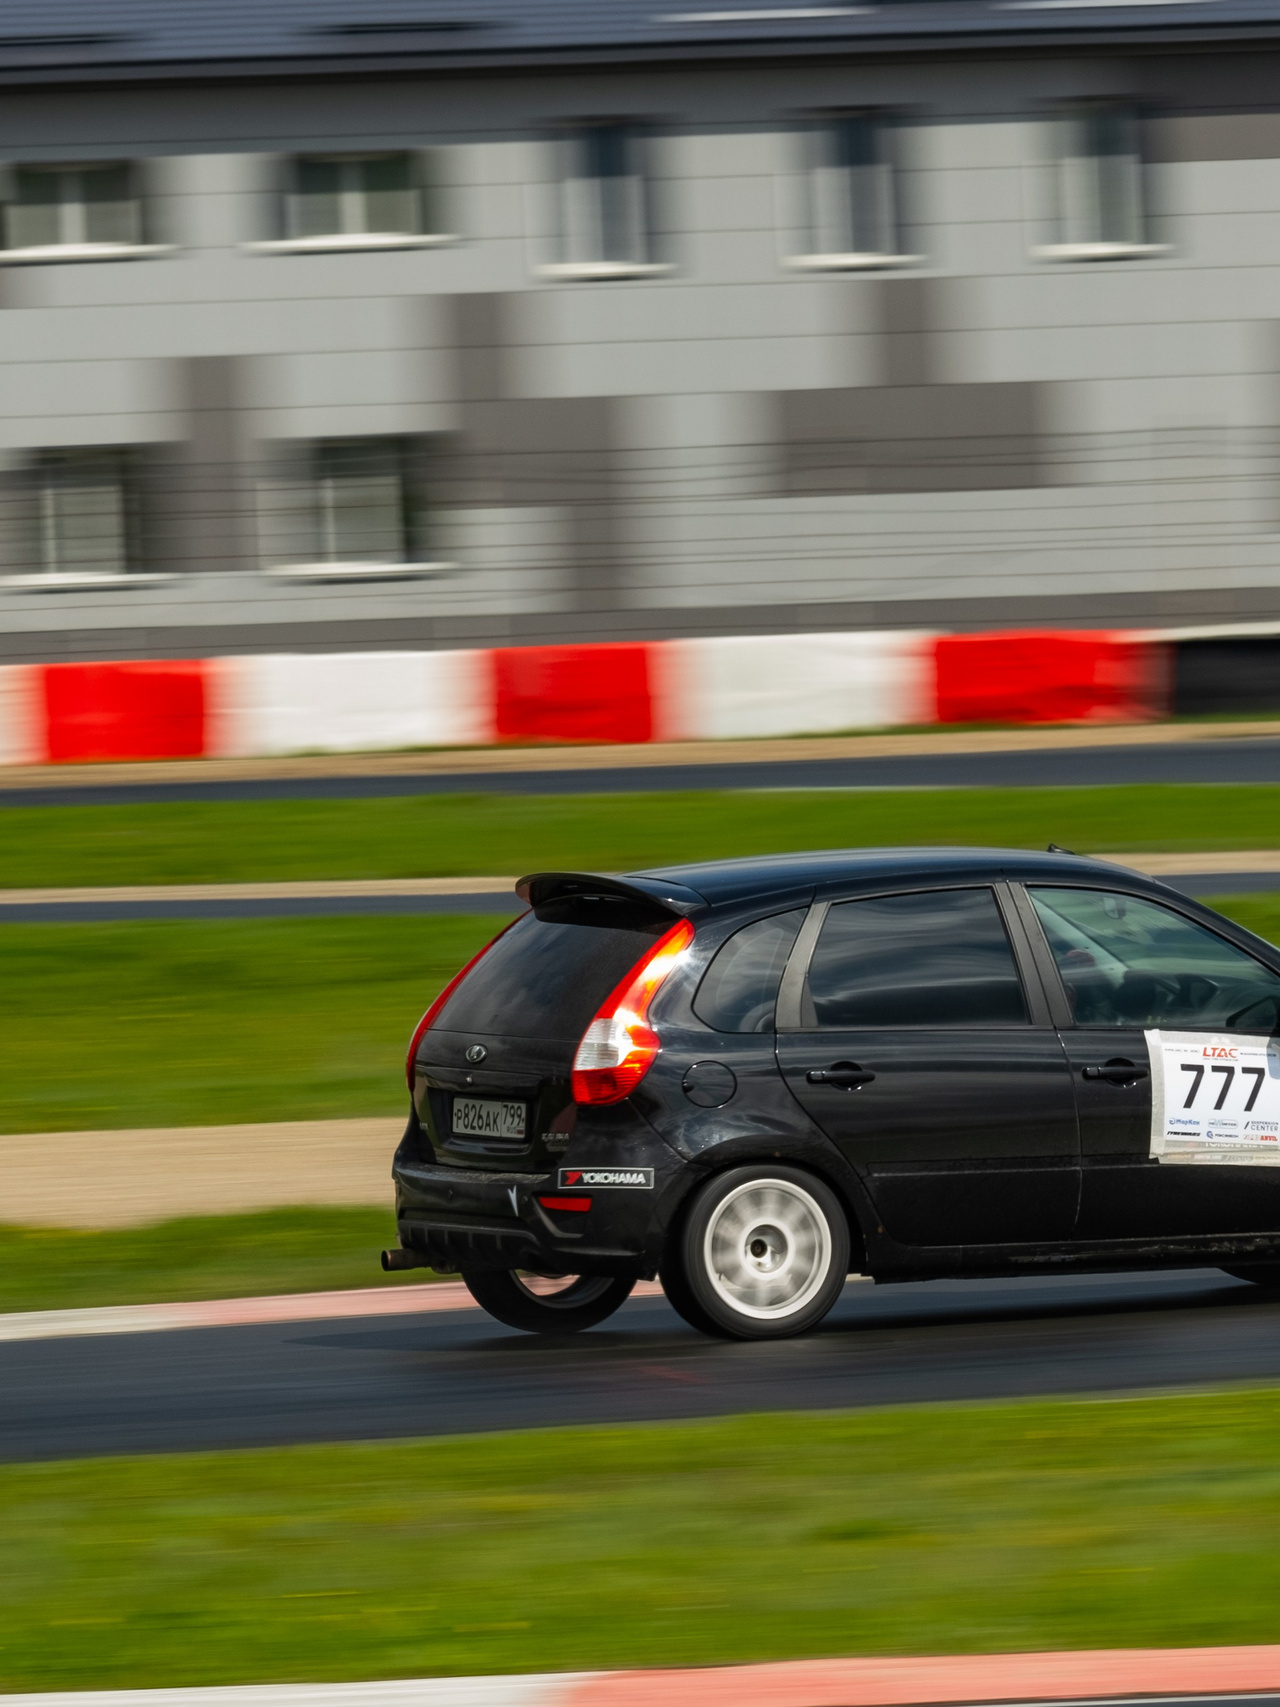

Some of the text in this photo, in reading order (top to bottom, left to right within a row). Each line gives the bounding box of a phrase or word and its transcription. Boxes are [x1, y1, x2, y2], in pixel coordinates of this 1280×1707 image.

[1202, 1046, 1238, 1059] LTAC
[1180, 1063, 1266, 1112] 777
[502, 1103, 523, 1127] 799
[582, 1172, 646, 1184] YOKOHAMA
